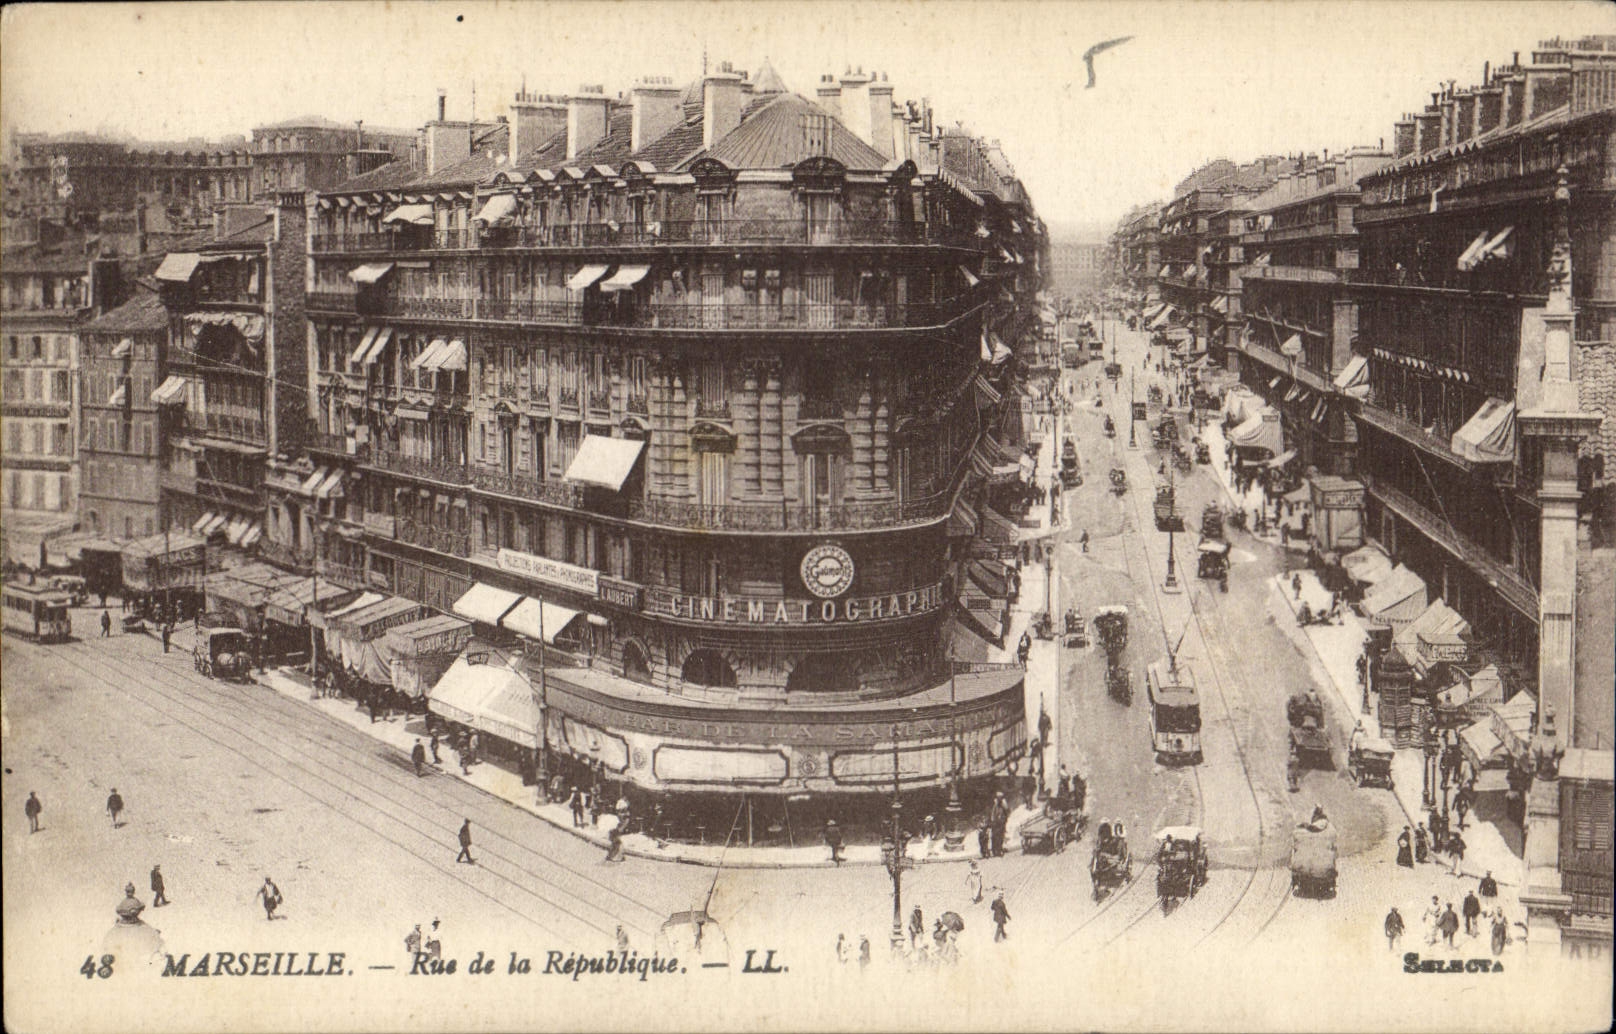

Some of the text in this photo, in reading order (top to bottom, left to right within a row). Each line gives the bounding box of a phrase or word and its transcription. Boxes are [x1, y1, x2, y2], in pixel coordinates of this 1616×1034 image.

[623, 715, 682, 734] BAR
[702, 722, 746, 738] DE
[769, 723, 814, 739] LA
